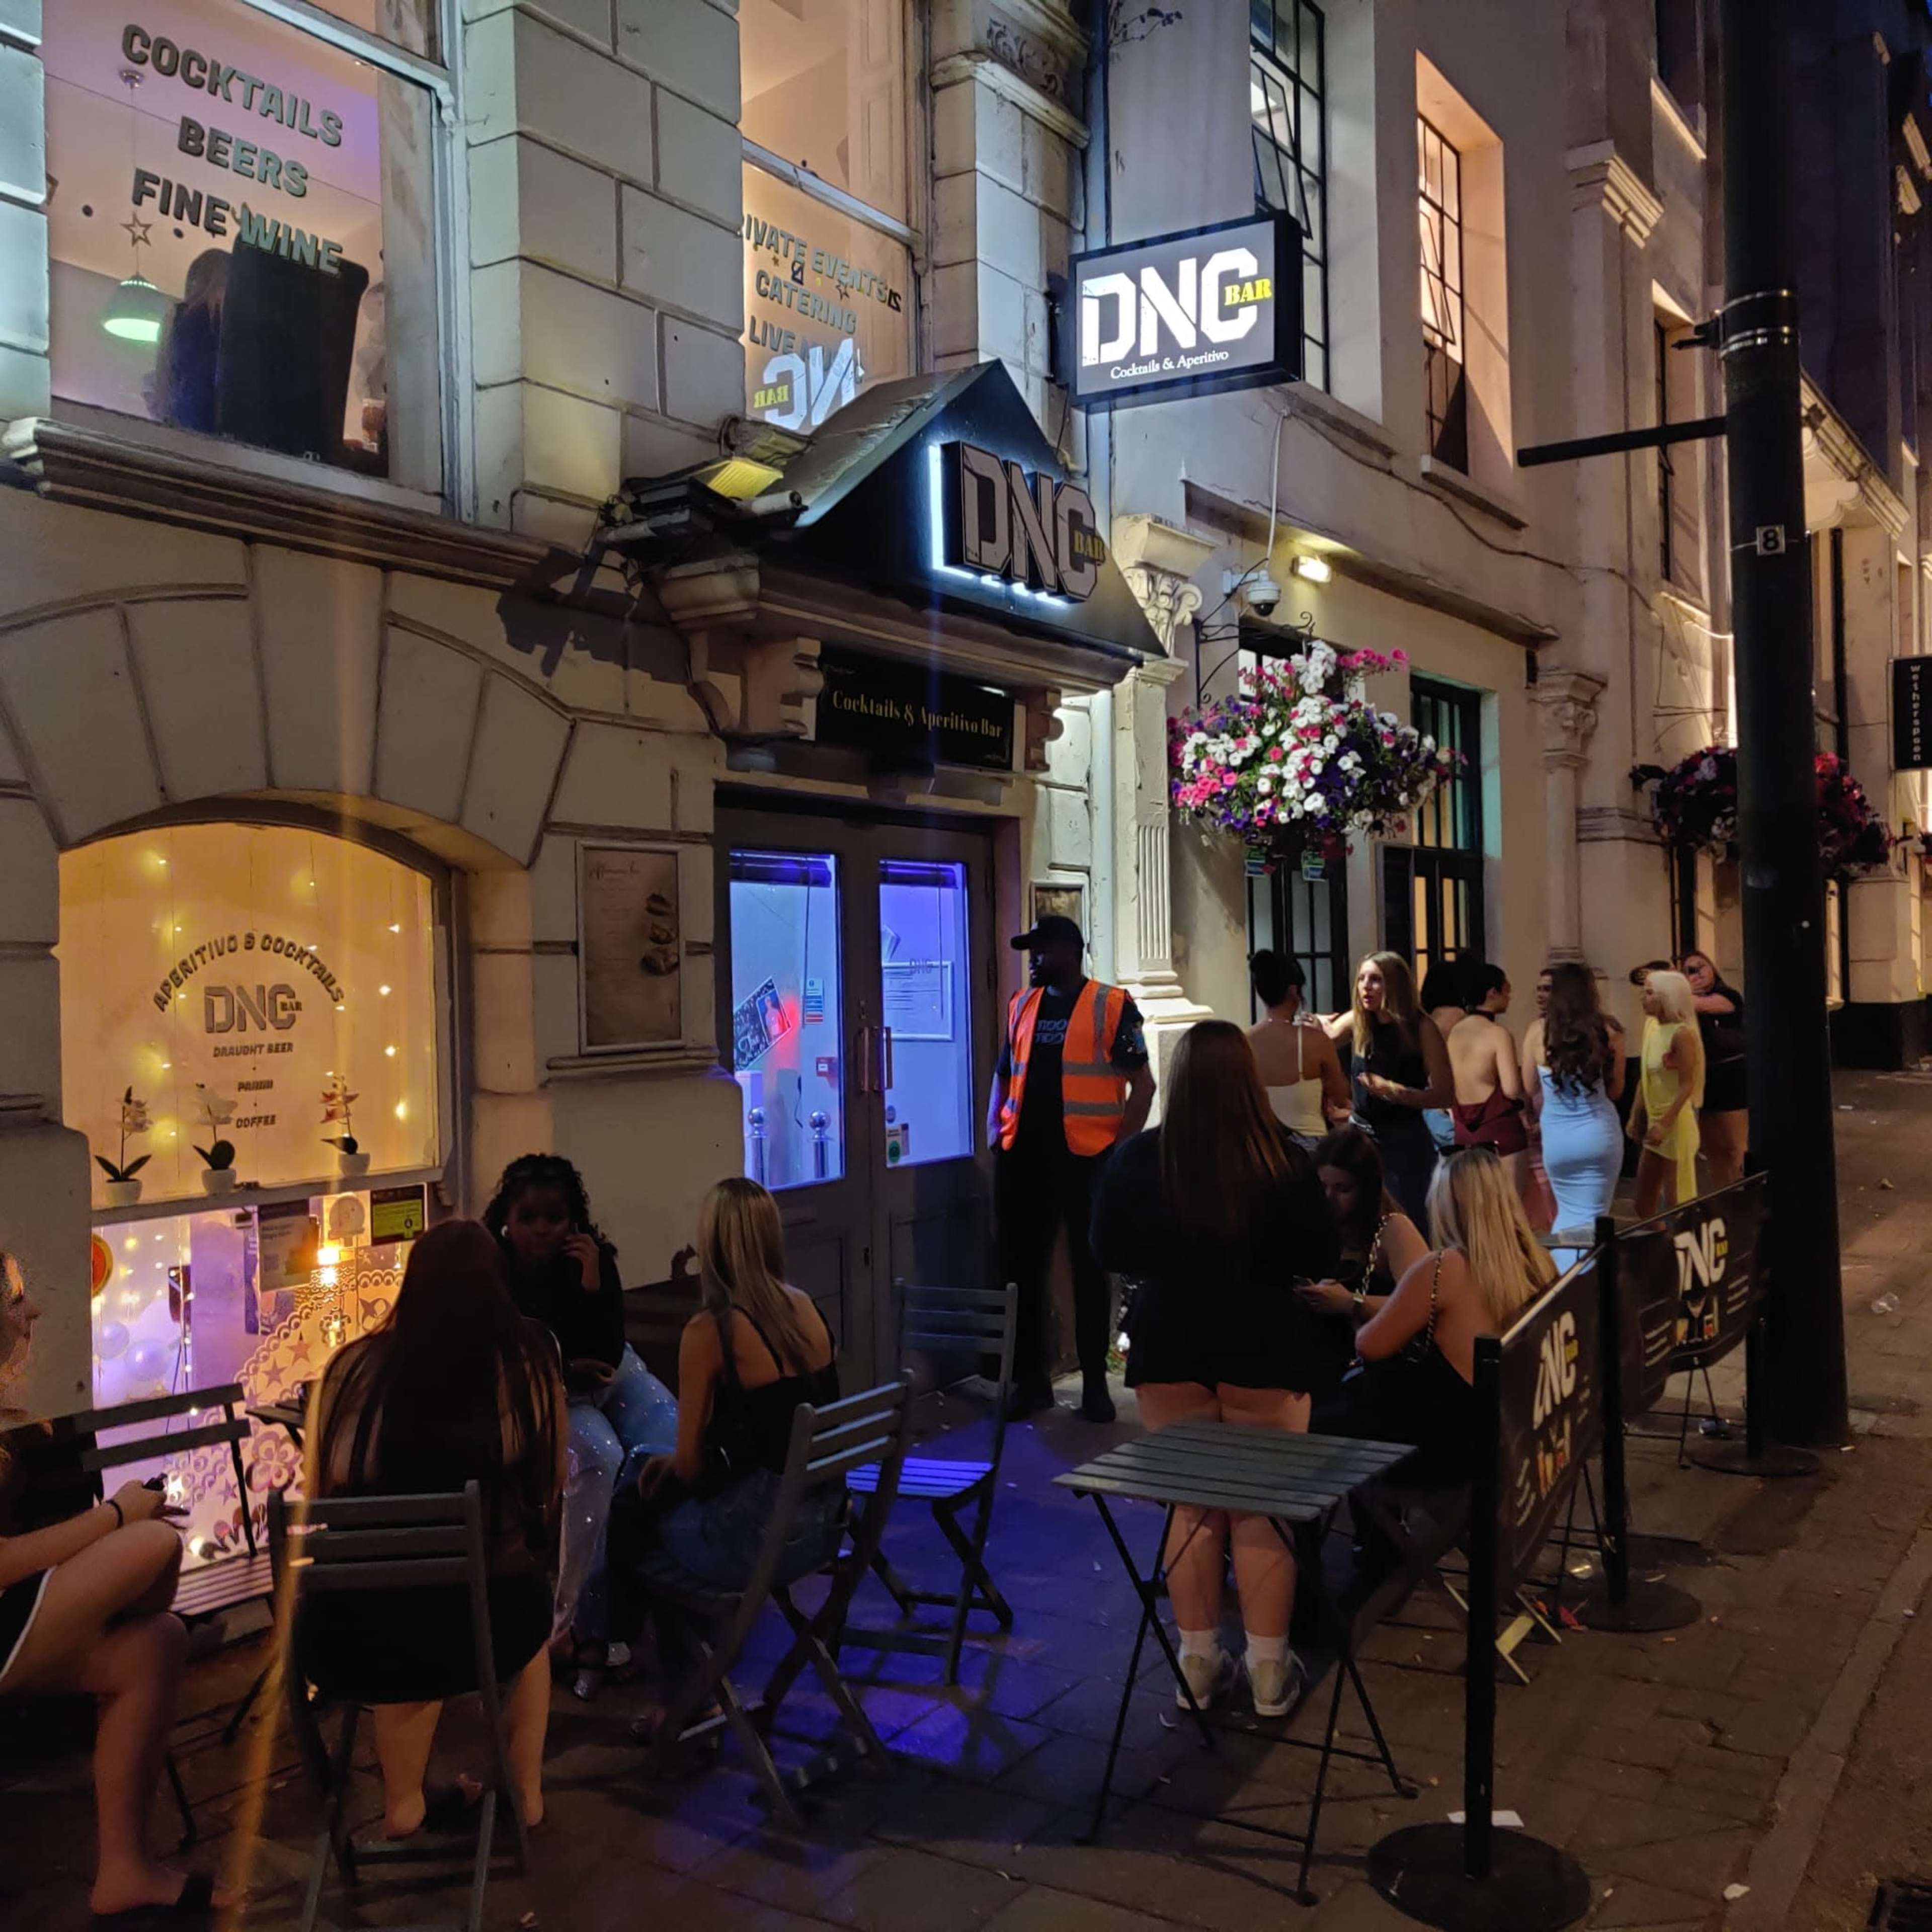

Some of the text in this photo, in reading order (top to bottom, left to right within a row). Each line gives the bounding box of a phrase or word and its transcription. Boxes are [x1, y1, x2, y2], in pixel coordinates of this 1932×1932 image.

[121, 24, 343, 147] COCKTAILS
[178, 116, 308, 198] BEERS
[132, 168, 343, 276] FINE WINE
[746, 215, 888, 303] IVATE EVENTS
[756, 269, 857, 334] CATERING
[1082, 248, 1272, 366] DNC BAR
[749, 315, 796, 355] LIVE
[1110, 350, 1229, 379] Cocktails & Aperitivo
[960, 441, 1106, 602] DNC BAR
[1761, 529, 1780, 551] 8
[833, 690, 1003, 738] Cocktails & Aperitivo Bar
[153, 934, 238, 1012] APERITIVO
[260, 933, 345, 1002] COCKTAILS
[204, 984, 296, 1033] DNC
[213, 1041, 293, 1058] DRAUGHT BEER
[236, 1114, 276, 1129] COFFEE
